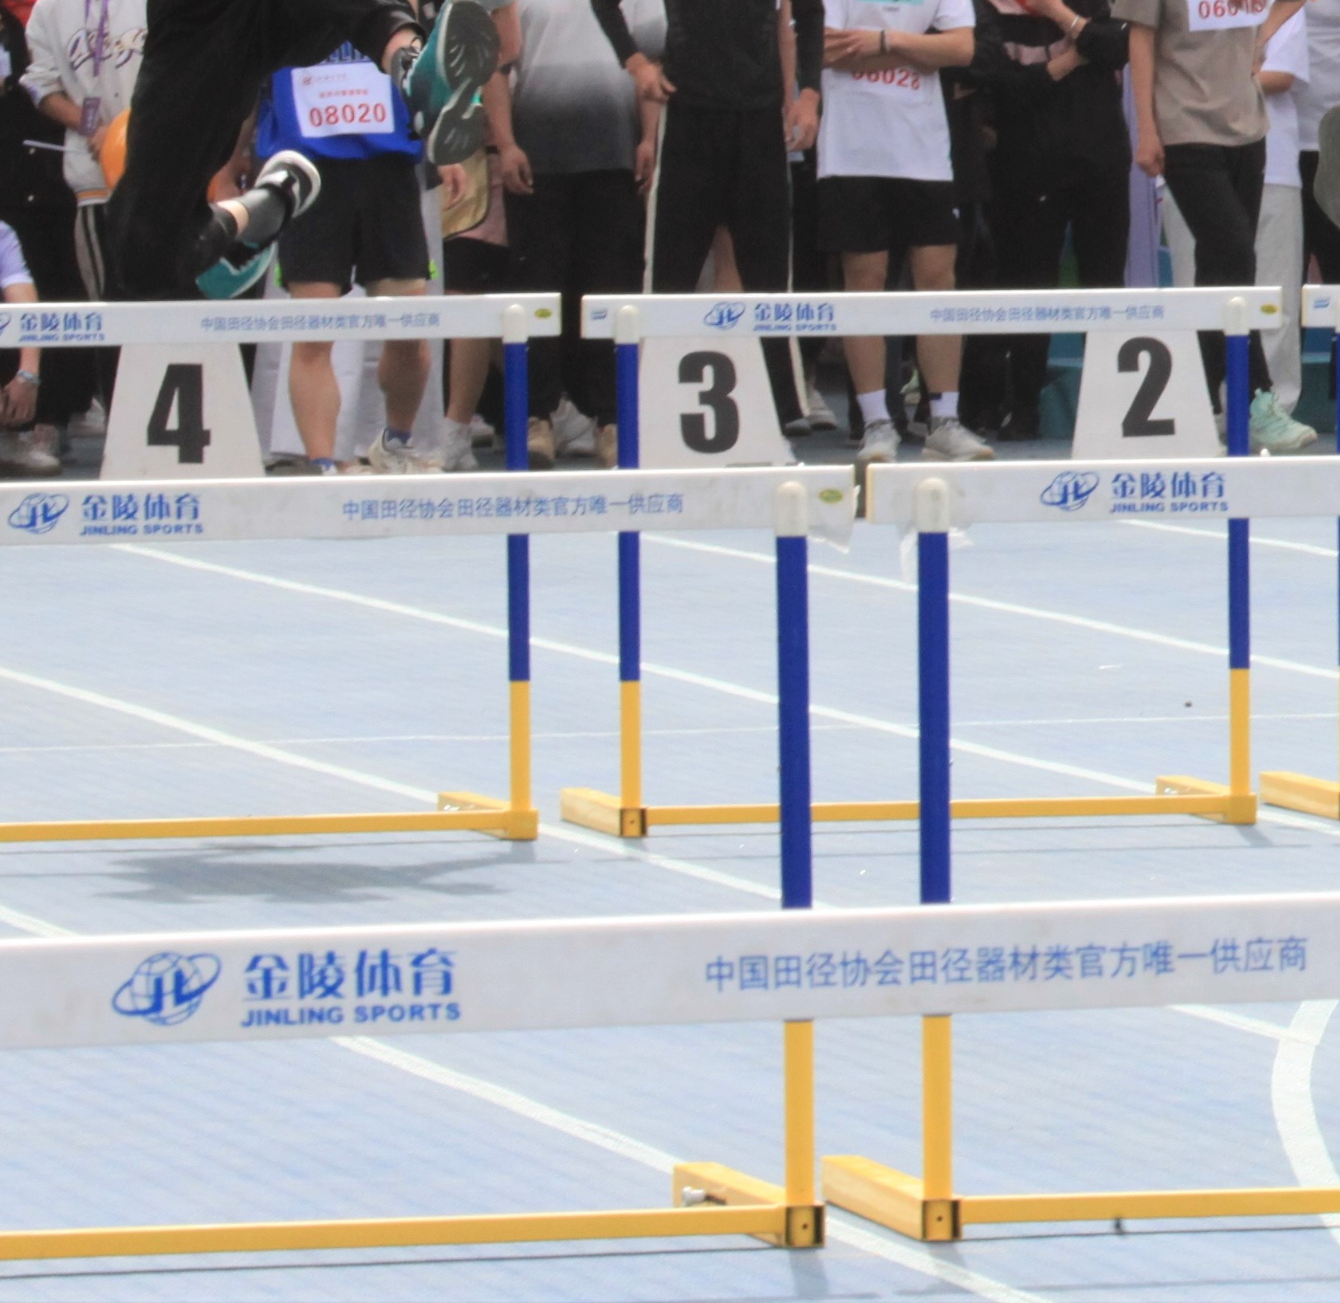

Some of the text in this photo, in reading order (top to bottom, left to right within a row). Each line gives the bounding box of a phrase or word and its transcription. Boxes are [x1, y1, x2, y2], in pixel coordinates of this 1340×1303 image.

[309, 103, 386, 127] 08020
[20, 312, 103, 333] 金陵体育
[753, 303, 835, 323] 金陵体育
[1117, 336, 1176, 438] 2
[146, 364, 211, 464] 4
[678, 351, 741, 454] 3
[1111, 472, 1225, 500] 金陵体育
[82, 494, 200, 523] 金陵体育
[341, 493, 683, 521] 中国田径协会田径器材类官方唯一供应商
[1112, 502, 1229, 513] JINLING SPORTS
[82, 524, 202, 535] JINLING SPORTS
[245, 948, 453, 1002] 金陵体育
[704, 936, 1307, 992] 中国田径协会田径器材类官方唯一供应商
[242, 1003, 460, 1028] JINLING SPORTS
